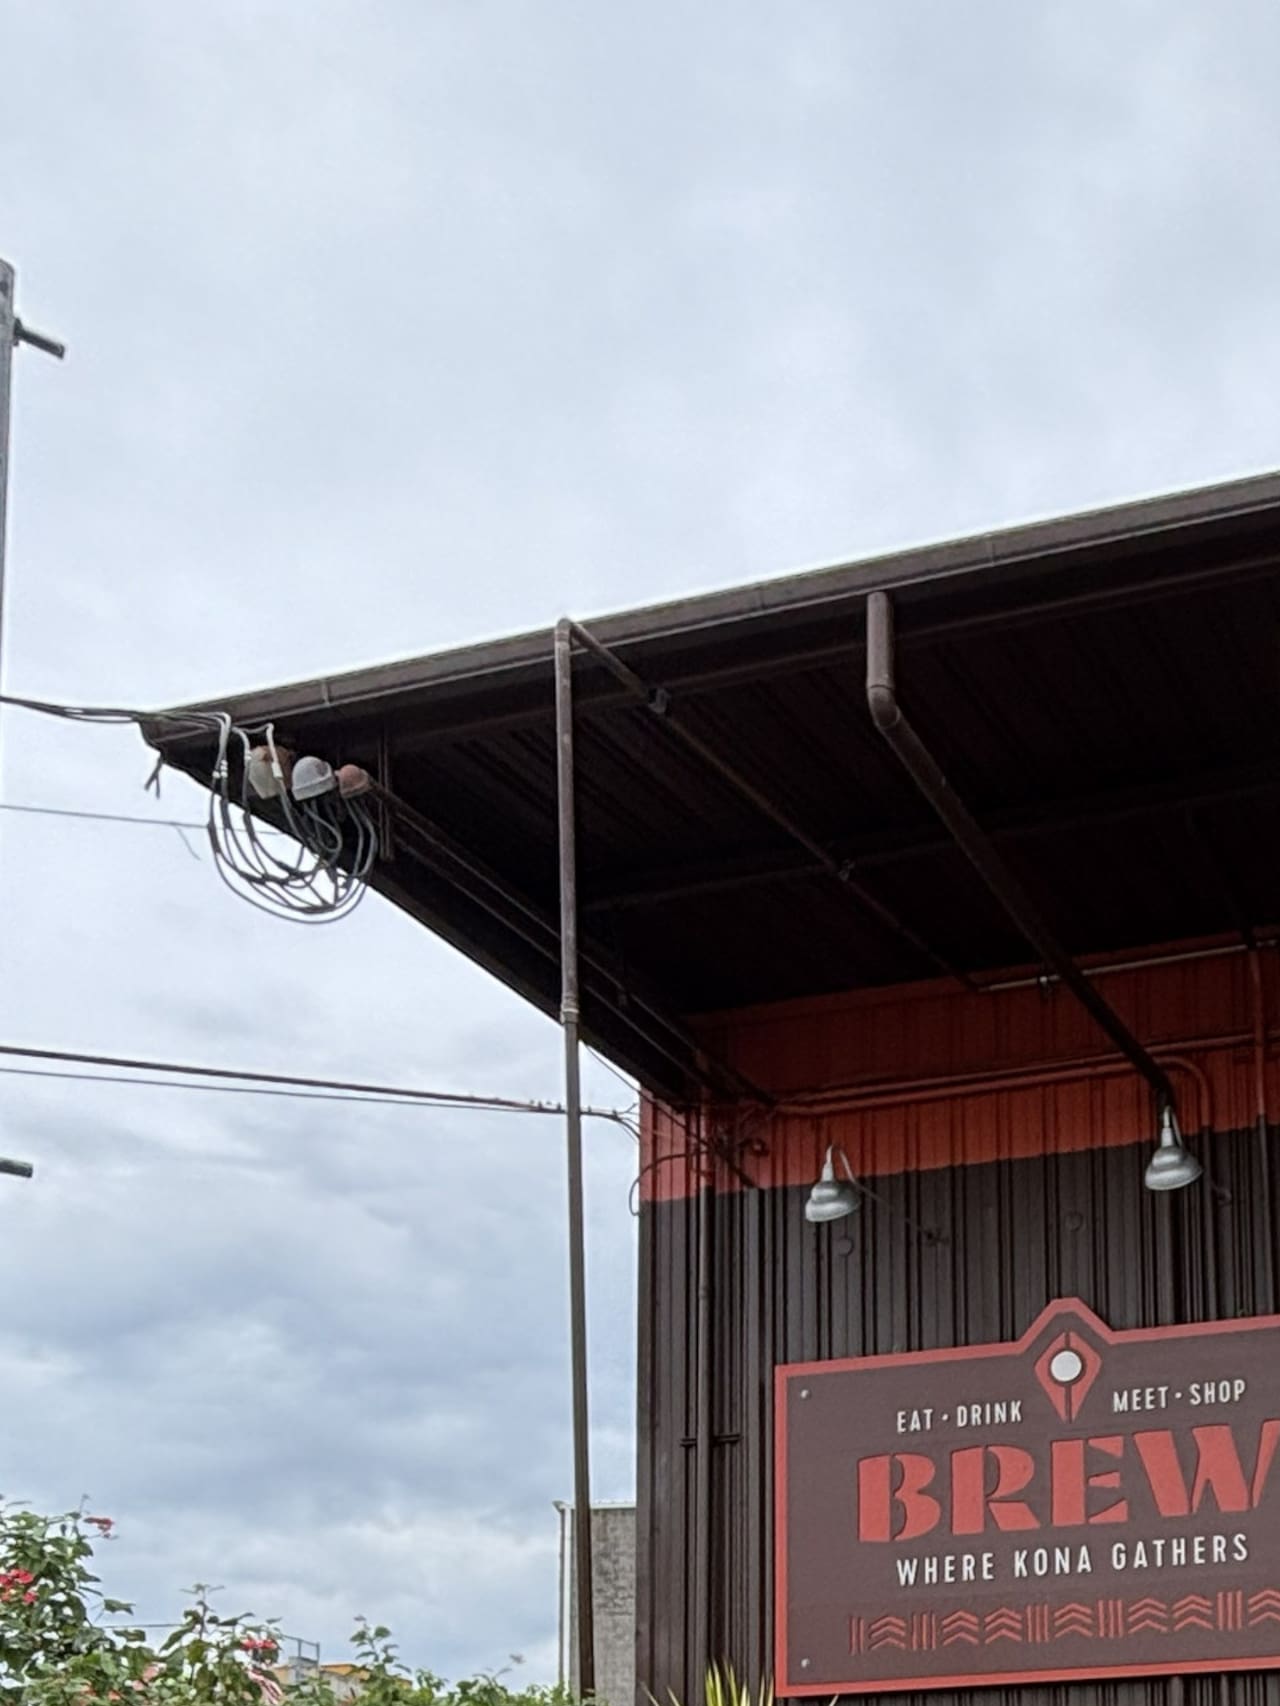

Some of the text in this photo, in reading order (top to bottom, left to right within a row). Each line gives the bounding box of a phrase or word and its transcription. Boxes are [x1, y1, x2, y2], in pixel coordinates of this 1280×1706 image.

[1112, 1379, 1247, 1414] MEET SHOP
[896, 1400, 1023, 1433] EAT DRINK
[896, 1533, 1250, 1587] WHERE KONA GATHERS
